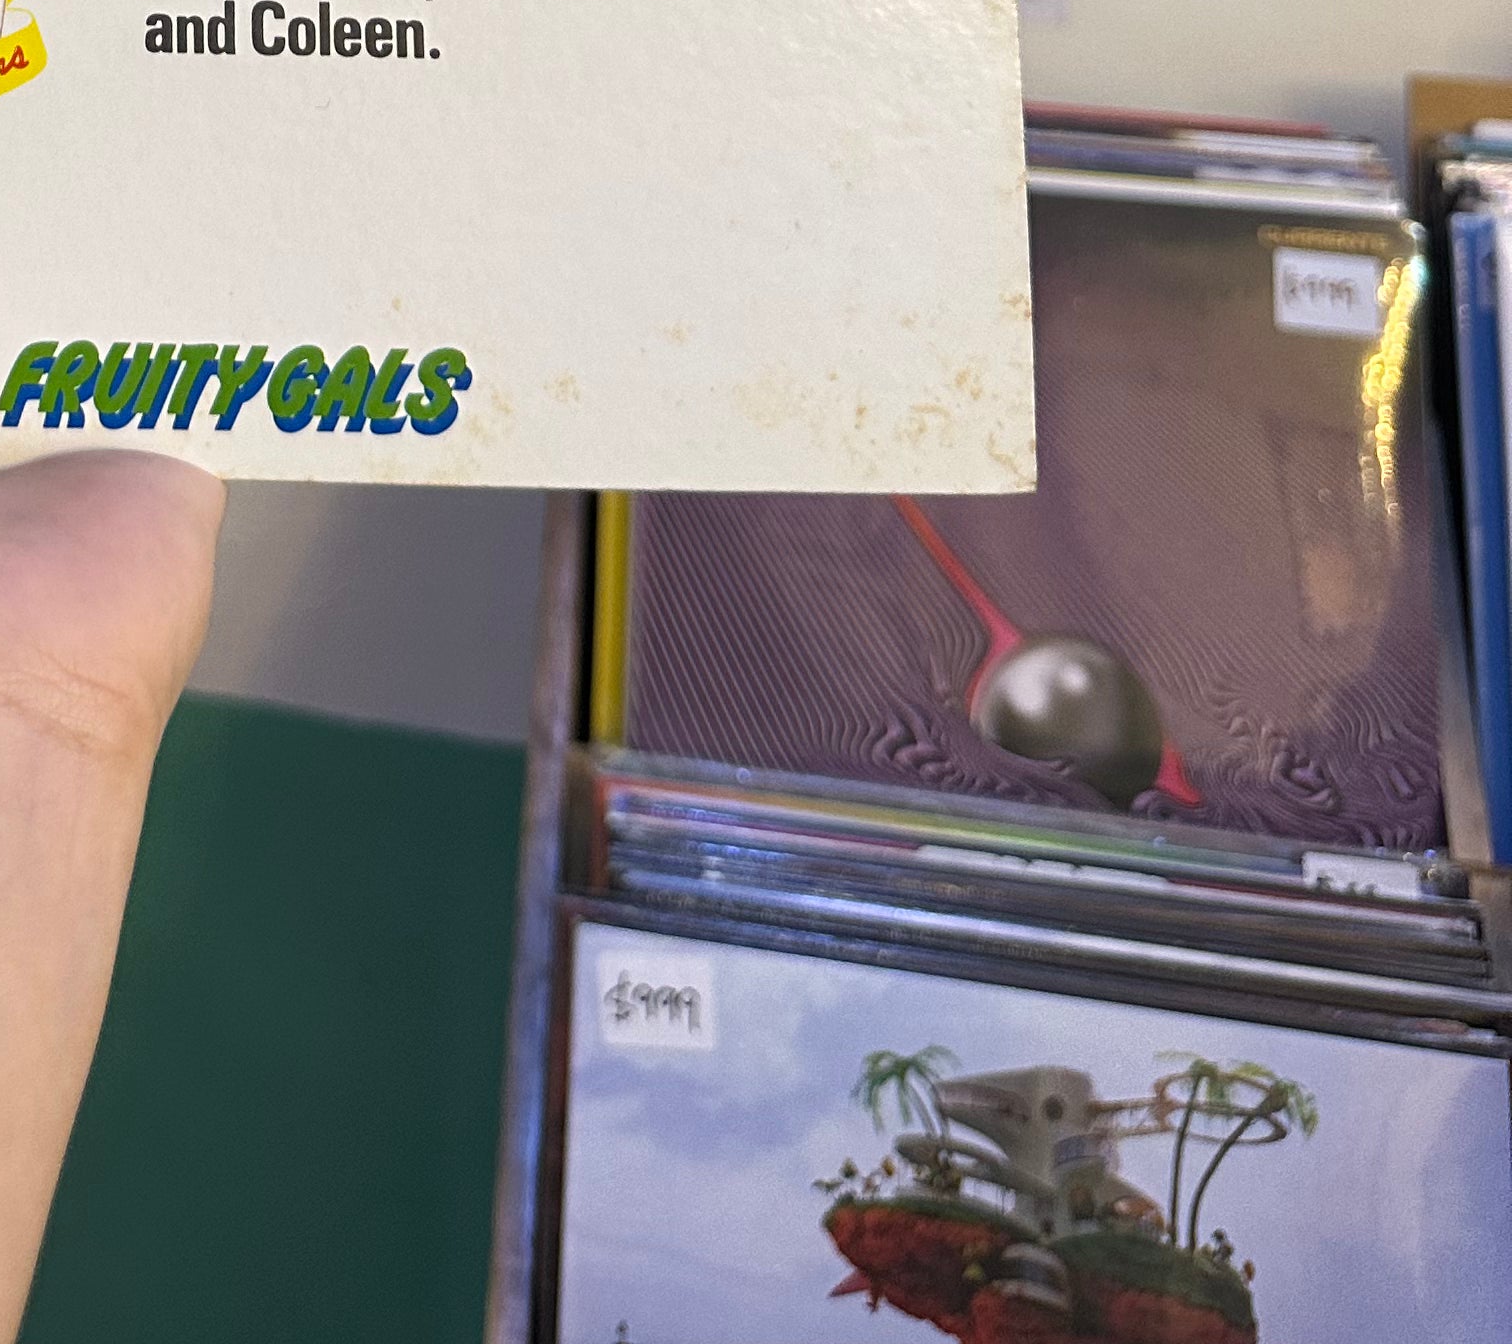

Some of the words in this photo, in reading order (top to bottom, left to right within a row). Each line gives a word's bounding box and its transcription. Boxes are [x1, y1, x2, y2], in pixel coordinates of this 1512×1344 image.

[144, 0, 236, 55] and
[251, 0, 441, 60] Coleen.
[266, 344, 474, 436] GALS
[603, 968, 702, 1034] $999
